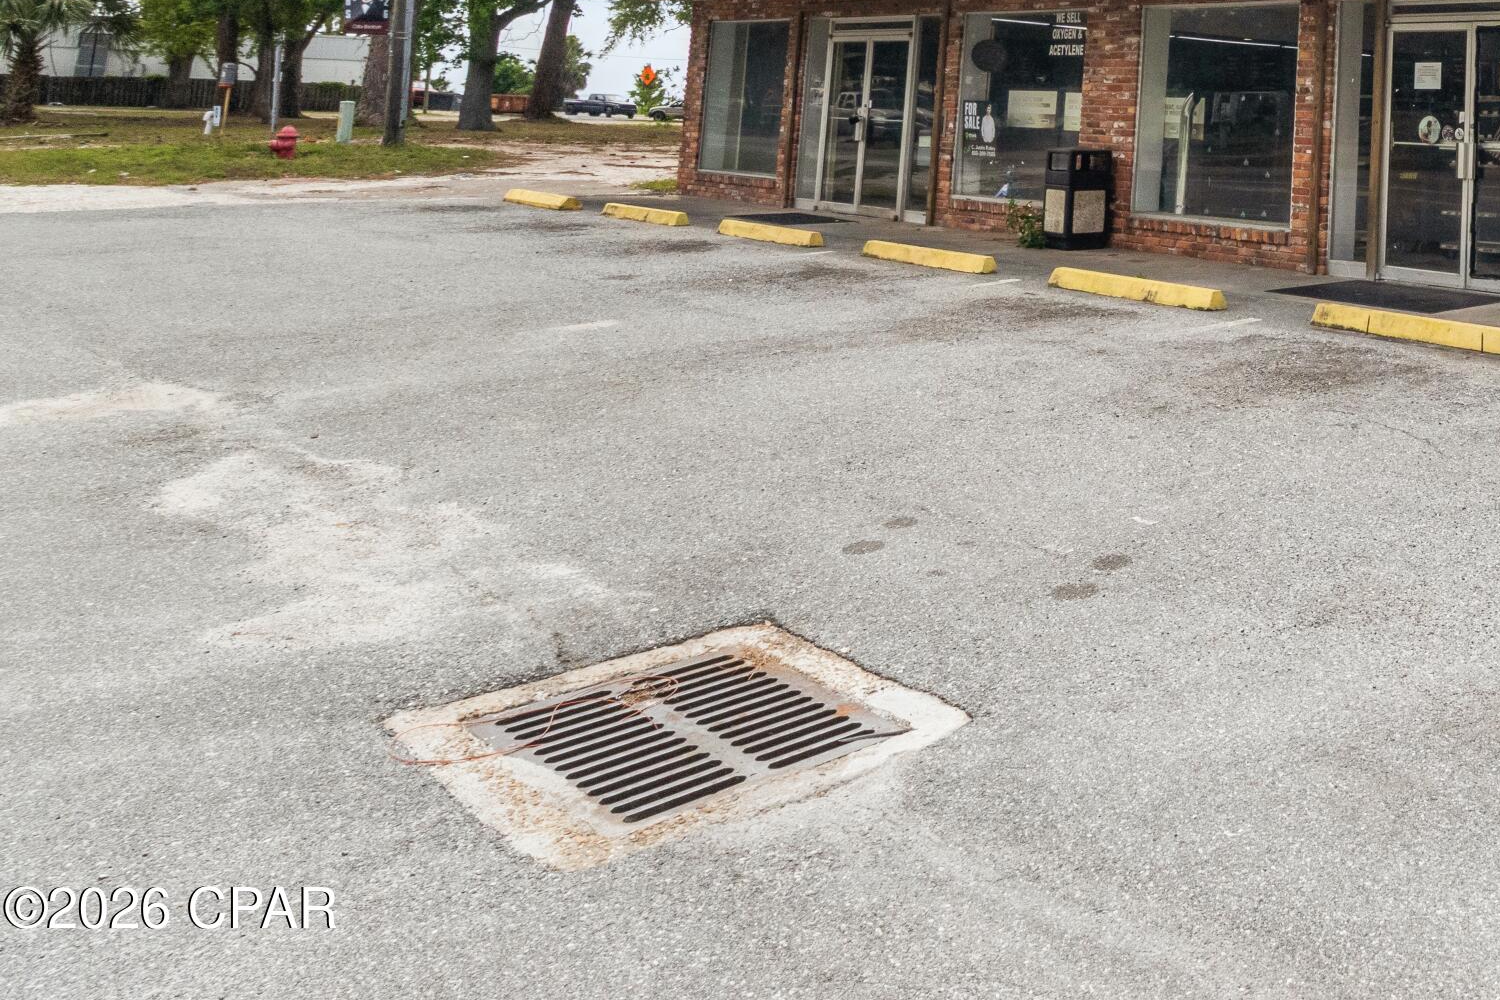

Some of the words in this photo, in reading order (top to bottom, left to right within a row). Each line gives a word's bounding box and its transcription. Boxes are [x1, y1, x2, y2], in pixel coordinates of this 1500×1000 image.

[1056, 12, 1066, 23] WE
[1067, 12, 1081, 23] SELL
[1052, 29, 1077, 40] OXYGEN
[1049, 45, 1084, 56] ACETYLENE
[964, 102, 977, 116] FOR
[964, 116, 980, 130] SALE
